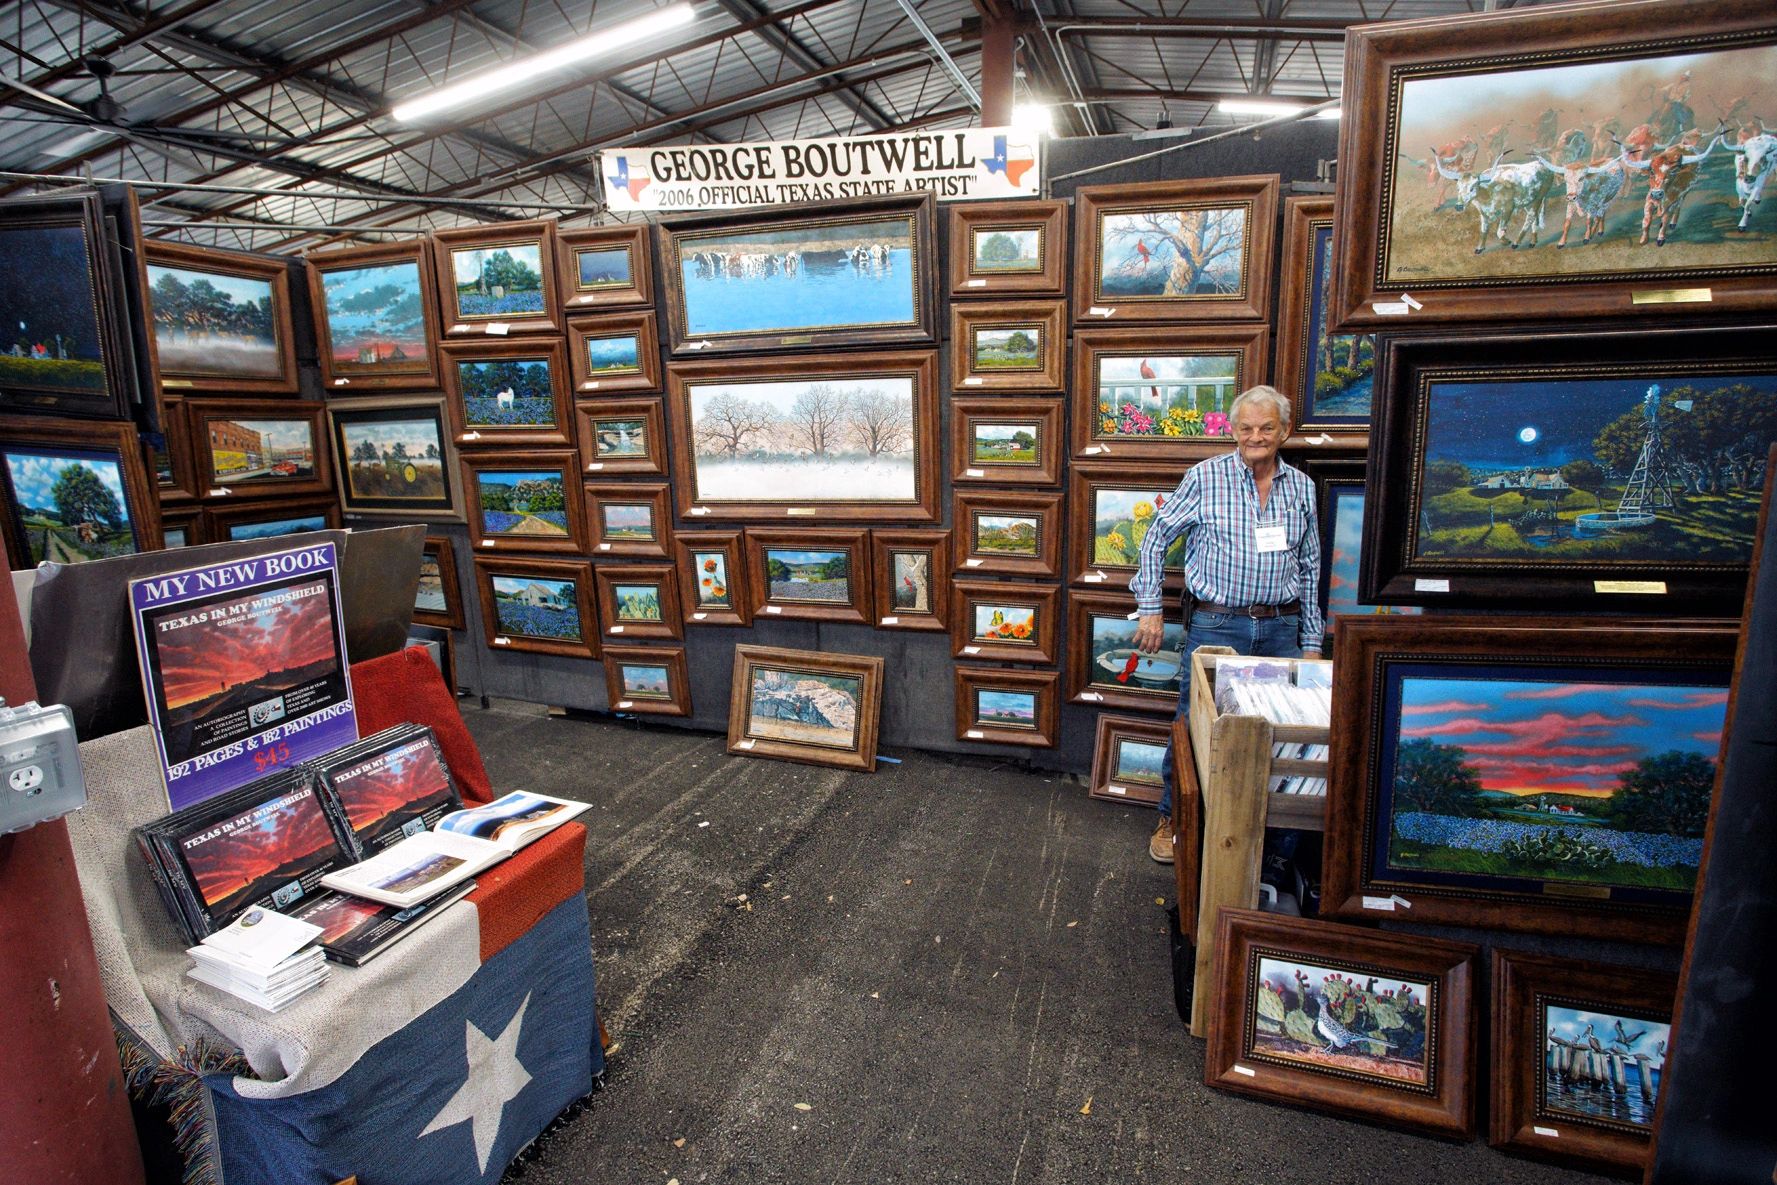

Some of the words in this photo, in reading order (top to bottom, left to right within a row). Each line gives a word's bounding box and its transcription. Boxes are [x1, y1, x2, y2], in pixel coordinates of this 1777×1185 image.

[650, 146, 776, 183] GEORGE
[781, 134, 976, 179] BOUTWELL
[699, 184, 775, 206] OFFICIAL
[776, 181, 834, 203] TEXAS
[839, 178, 896, 199] STATE
[144, 575, 191, 602] MY
[196, 563, 258, 591] NEW
[265, 548, 330, 577] BOOK
[158, 612, 208, 632] TEXAS
[210, 607, 227, 620] IN
[228, 602, 249, 616] MY
[251, 584, 325, 609] WINDSHIELD
[217, 614, 247, 627] GEORGE
[167, 763, 191, 782] 192
[193, 743, 244, 772] PAGES
[246, 737, 259, 751] &
[261, 729, 281, 745] 182
[283, 700, 353, 737] PAINTINGS
[200, 739, 214, 747] AND
[213, 733, 229, 742] ROAD
[255, 742, 290, 773] $45
[334, 768, 362, 784] TEXAS
[361, 763, 372, 773] IN
[371, 758, 384, 768] MY
[384, 739, 429, 763] WINDSHIELD
[184, 828, 221, 849] TEXAS
[221, 822, 236, 833] IN
[235, 814, 252, 827] MY
[253, 789, 312, 818] WINDSHIELD
